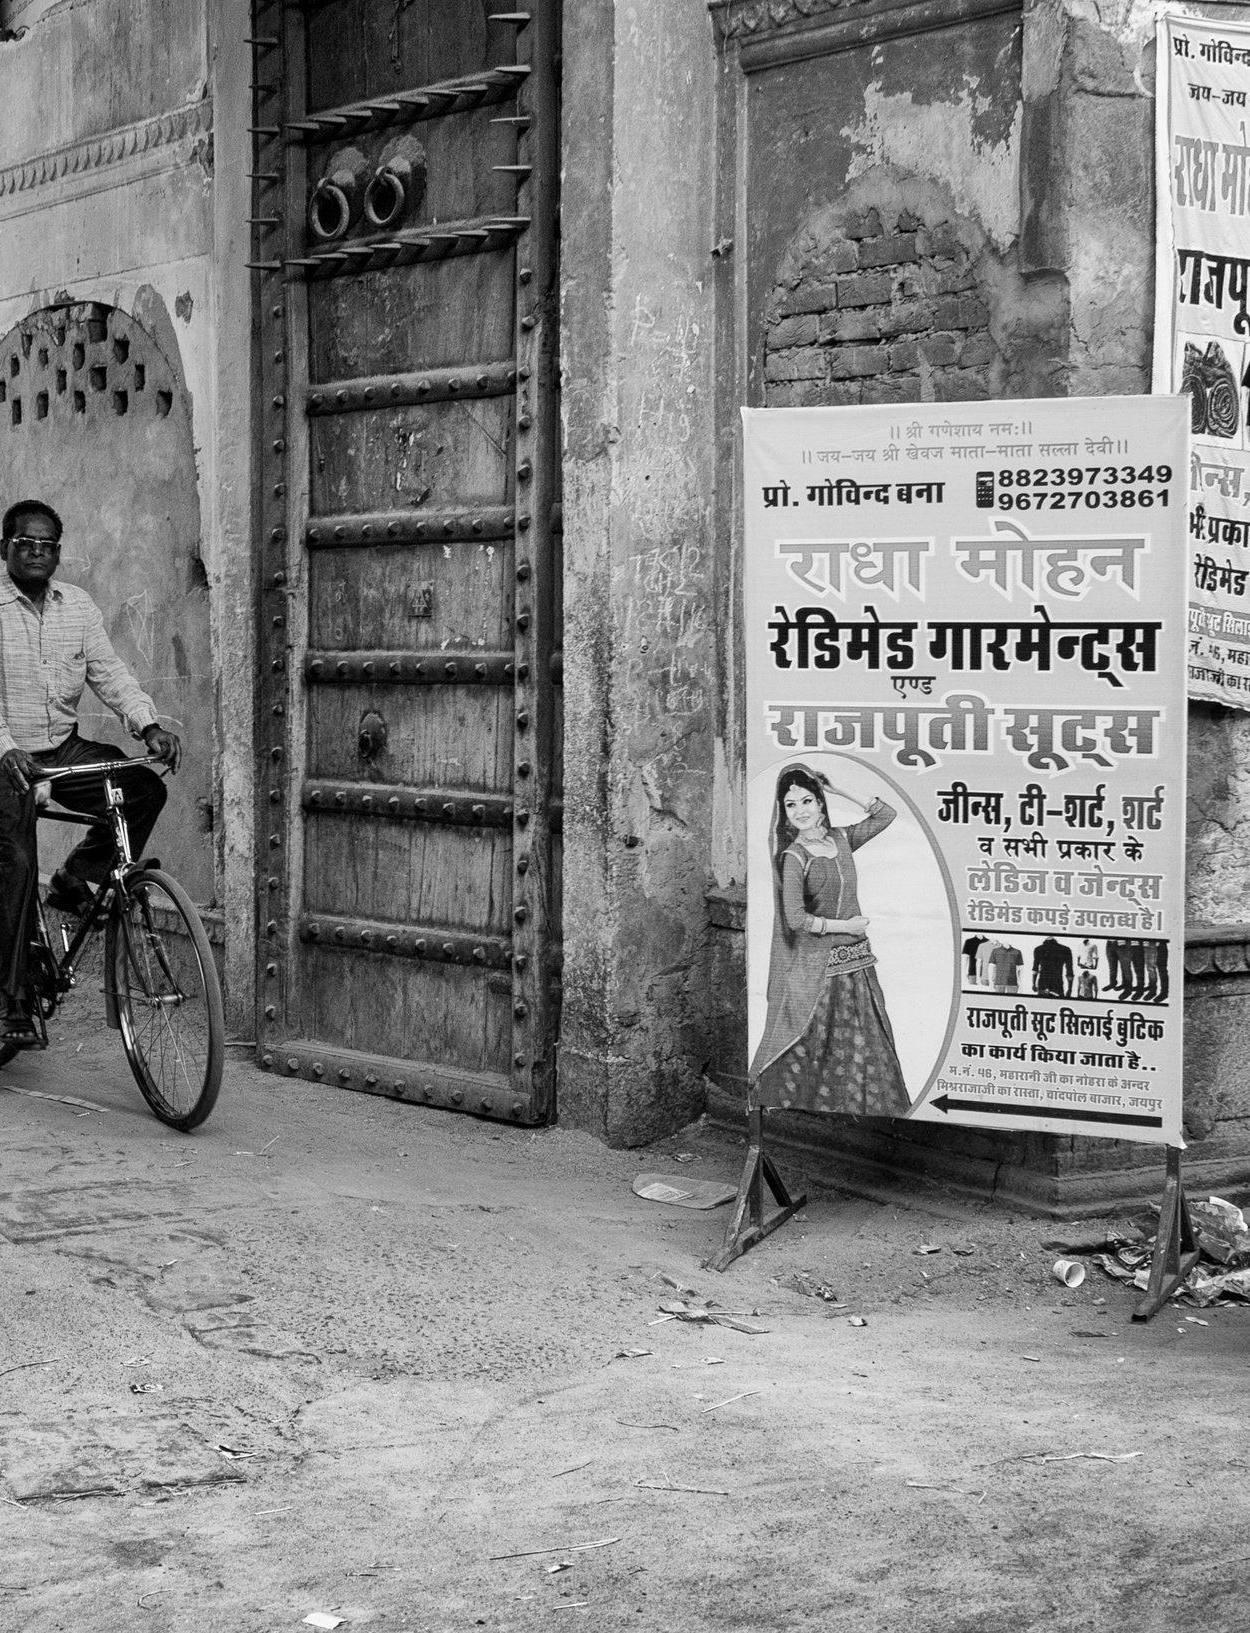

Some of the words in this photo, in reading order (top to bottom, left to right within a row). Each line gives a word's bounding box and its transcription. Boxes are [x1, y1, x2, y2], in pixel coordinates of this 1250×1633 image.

[1172, 33, 1195, 59] प्रो.
[1221, 120, 1250, 216] मो
[905, 420, 923, 439] श्री
[929, 421, 983, 438] गणेशाय
[882, 443, 900, 462] श्री
[1039, 442, 1078, 457] सल्ला
[998, 464, 1173, 487] 8823973349
[762, 480, 799, 508] प्रो.
[806, 478, 892, 506] गोविन्द
[895, 482, 946, 504] बना
[998, 489, 1169, 511] 9672703861
[779, 541, 930, 593] राधा
[955, 520, 1145, 597] मोहन
[1193, 553, 1250, 596] रेडिमेड
[767, 605, 918, 670] रेडिमेड
[927, 604, 1163, 688] गारमेन्ट्स
[890, 675, 937, 699] एण्ड
[768, 694, 995, 768] राजपूती
[1003, 708, 1161, 771] सूट्स
[937, 781, 1012, 833] जीन्स,
[1018, 783, 1115, 836] टी-शर्ट,
[1122, 785, 1165, 830] शर्ट
[978, 836, 995, 856] व
[1002, 831, 1048, 858] सभी
[1056, 839, 1116, 861] प्रकार
[1123, 835, 1144, 862] के
[967, 860, 1049, 894] लेडिज
[1053, 871, 1074, 895] व
[967, 899, 1023, 923] रेडिमेड
[1026, 903, 1070, 931] कपड़े
[1074, 909, 1138, 930] उपलब्ध
[966, 1004, 1028, 1039] राजपूती
[1031, 1011, 1057, 1041] सूट
[1060, 1008, 1114, 1041] सिलाई
[1116, 1012, 1165, 1047] बुटिक
[961, 1043, 985, 1058] का
[988, 1043, 1028, 1061] कार्य
[1031, 1045, 1077, 1065] किया
[1080, 1051, 1125, 1069] जाता
[999, 1069, 1042, 1082] महारानी
[1043, 1071, 1058, 1083] जी
[1059, 1074, 1074, 1085] का
[1108, 1076, 1119, 1088] के
[1121, 1079, 1150, 1091] अन्दर
[997, 1086, 1011, 1096] का
[1046, 1087, 1088, 1103] चांदपोल
[1128, 1096, 1163, 1112] जयपुर
